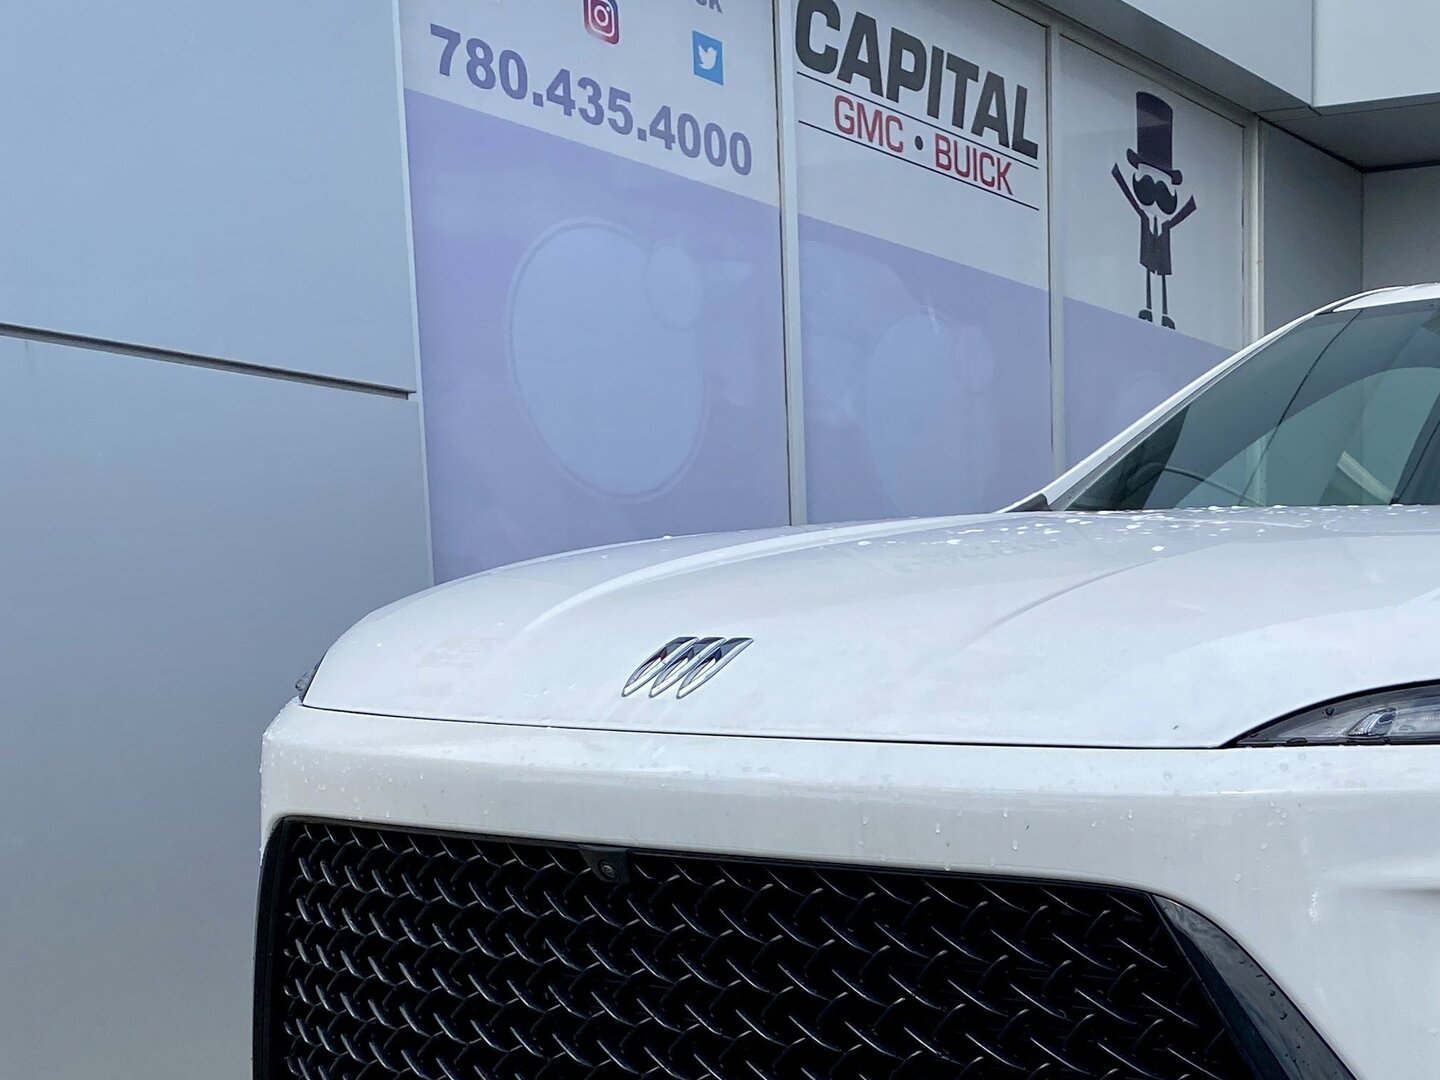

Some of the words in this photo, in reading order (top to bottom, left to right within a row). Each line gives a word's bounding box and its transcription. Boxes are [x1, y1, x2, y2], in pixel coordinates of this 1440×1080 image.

[430, 23, 751, 176] 780.435.4000
[795, 0, 1038, 160] CAPITAL
[834, 95, 904, 153] GMC
[934, 133, 1013, 195] BUICK
